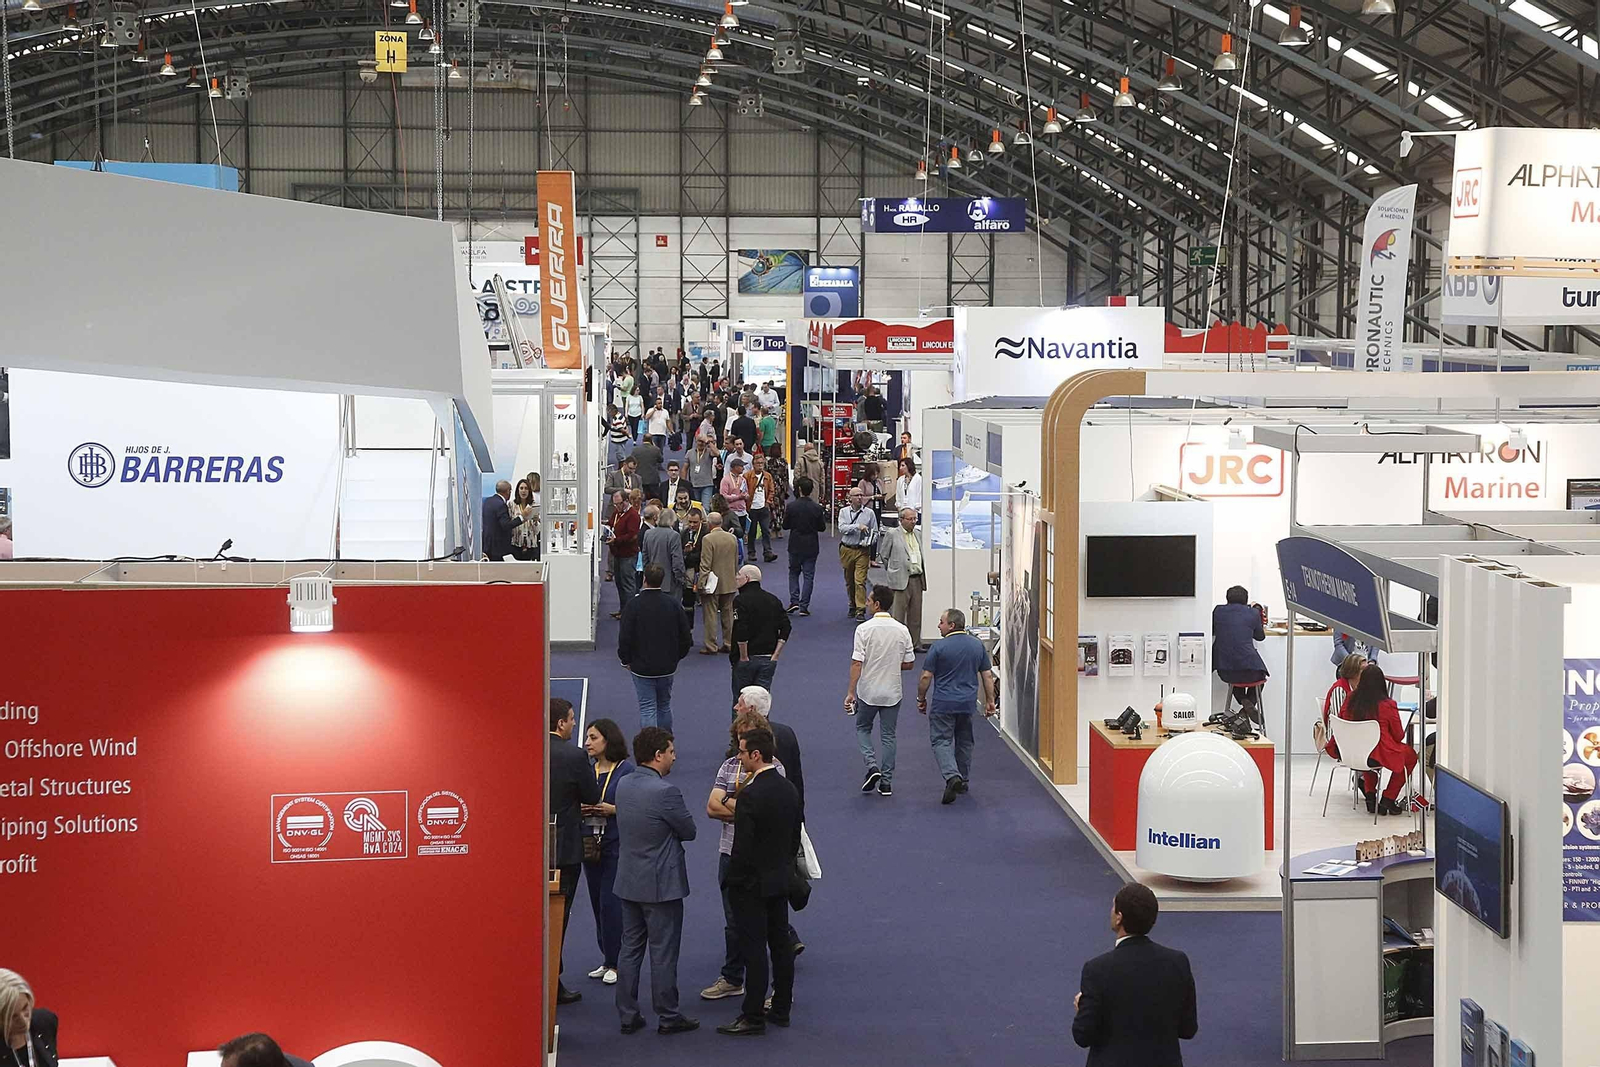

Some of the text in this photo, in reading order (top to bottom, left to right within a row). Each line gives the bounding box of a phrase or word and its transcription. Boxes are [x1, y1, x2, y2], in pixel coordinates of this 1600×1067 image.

[379, 35, 403, 43] ZONA
[387, 50, 396, 63] H
[1457, 179, 1479, 207] JRC
[899, 204, 940, 212] RAMALLO
[1571, 201, 1600, 223] M
[974, 220, 1010, 230] alfaro
[547, 202, 571, 352] GUERRA
[1366, 274, 1385, 372] RONAUTIC
[766, 339, 784, 349] Top
[922, 341, 947, 349] LINCOLN
[1028, 337, 1139, 359] Navantia
[126, 446, 171, 454] HIJOS DE J.
[120, 456, 285, 483] BARRERAS
[1188, 455, 1273, 485] JRC
[1444, 477, 1540, 499] Marine
[0, 701, 39, 725] ding
[1173, 710, 1196, 719] SAILOR
[1569, 699, 1600, 715] Prop
[5, 737, 138, 759] Offshore Wind
[0, 777, 132, 798] etal Structures
[294, 796, 316, 804] SYSTEM
[1, 814, 139, 841] iping Solutions
[363, 830, 402, 843] MGMT. SYS.
[363, 842, 380, 855] RvA
[1148, 828, 1221, 850] Intellian
[0, 853, 37, 874] rofit
